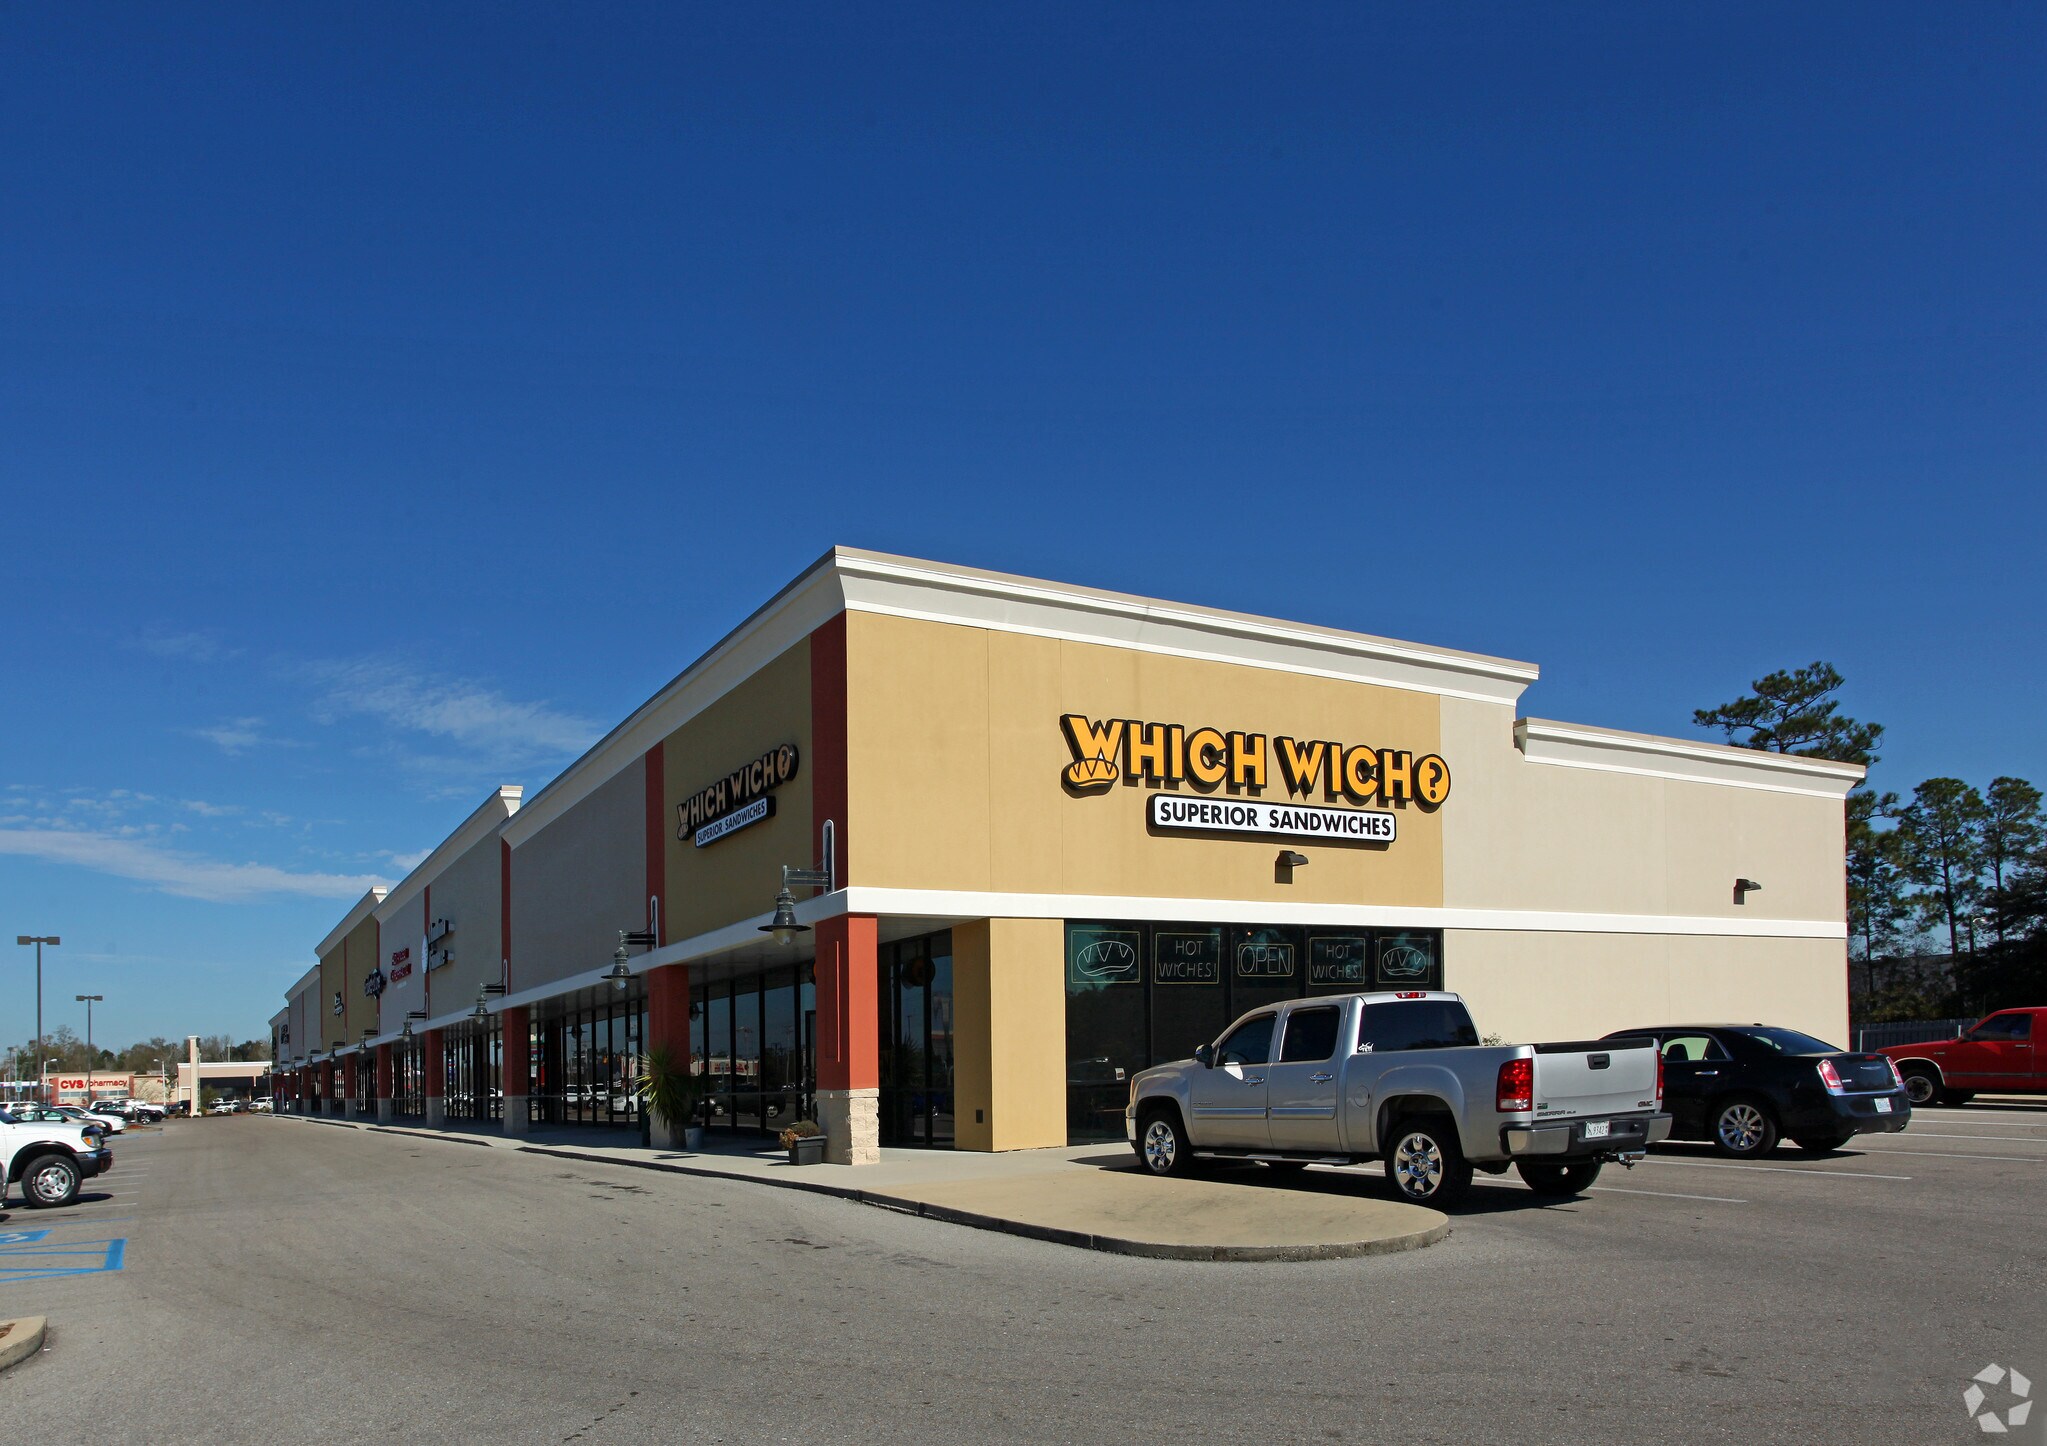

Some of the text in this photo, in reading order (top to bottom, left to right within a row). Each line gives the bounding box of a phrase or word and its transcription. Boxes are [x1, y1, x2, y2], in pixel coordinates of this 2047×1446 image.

[1060, 714, 1267, 792] WHICH
[677, 780, 728, 830] WHICH
[1159, 802, 1391, 837] SUPERIOR SANDWICHES
[697, 801, 765, 843] SUPERIOR SANDWICHES
[1175, 940, 1203, 956] HOT
[1240, 945, 1291, 974] OPEN
[1326, 944, 1351, 959] HOT
[1158, 962, 1217, 978] WICHES!
[1312, 964, 1364, 980] WICHES!
